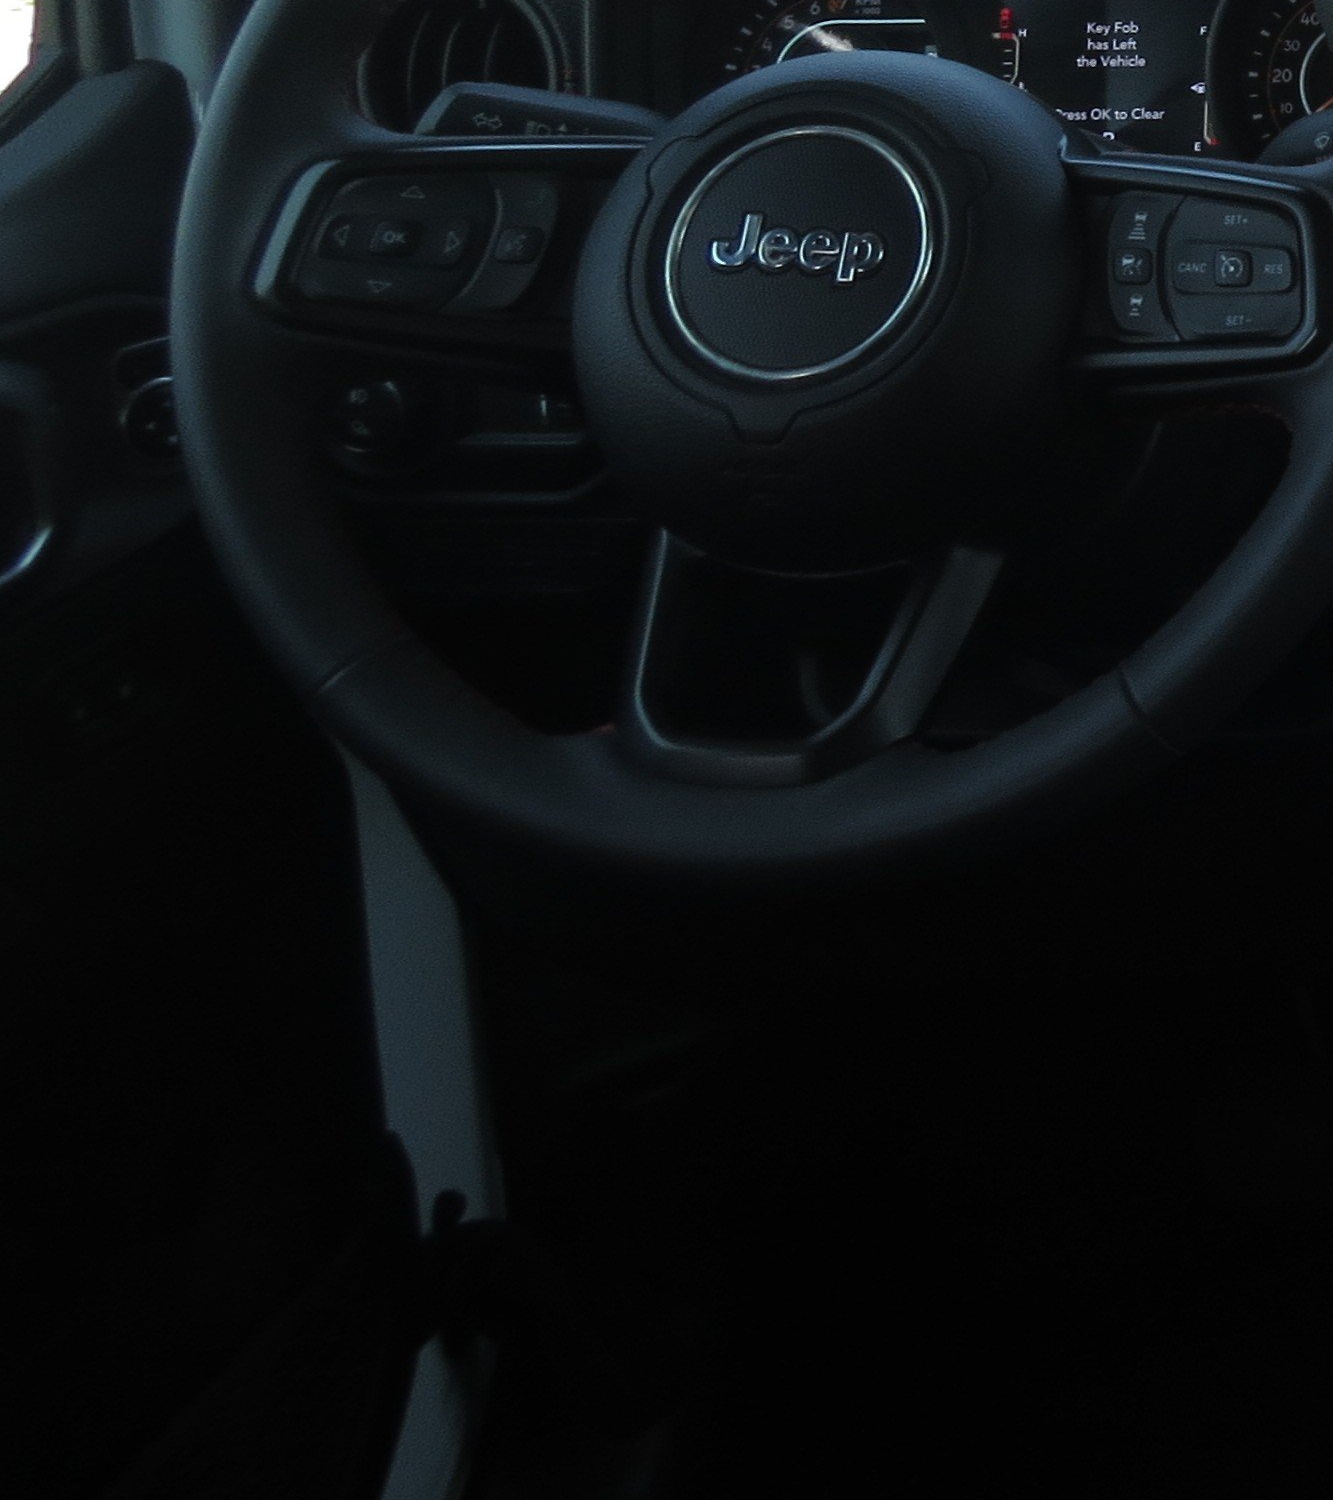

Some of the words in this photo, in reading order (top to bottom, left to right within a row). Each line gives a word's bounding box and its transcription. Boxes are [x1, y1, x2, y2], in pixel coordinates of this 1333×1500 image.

[1086, 22, 1111, 35] Key
[1114, 21, 1140, 34] Fob
[1086, 39, 1109, 51] has
[1112, 38, 1138, 51] Left
[1284, 39, 1300, 52] 30
[1076, 55, 1097, 67] the
[1100, 55, 1147, 67] Vehicle
[1272, 68, 1293, 83] 20
[1090, 108, 1111, 121] OK
[1114, 108, 1128, 120] to
[1131, 107, 1165, 120] Clear
[1279, 103, 1294, 114] 10
[709, 212, 886, 285] Jeep
